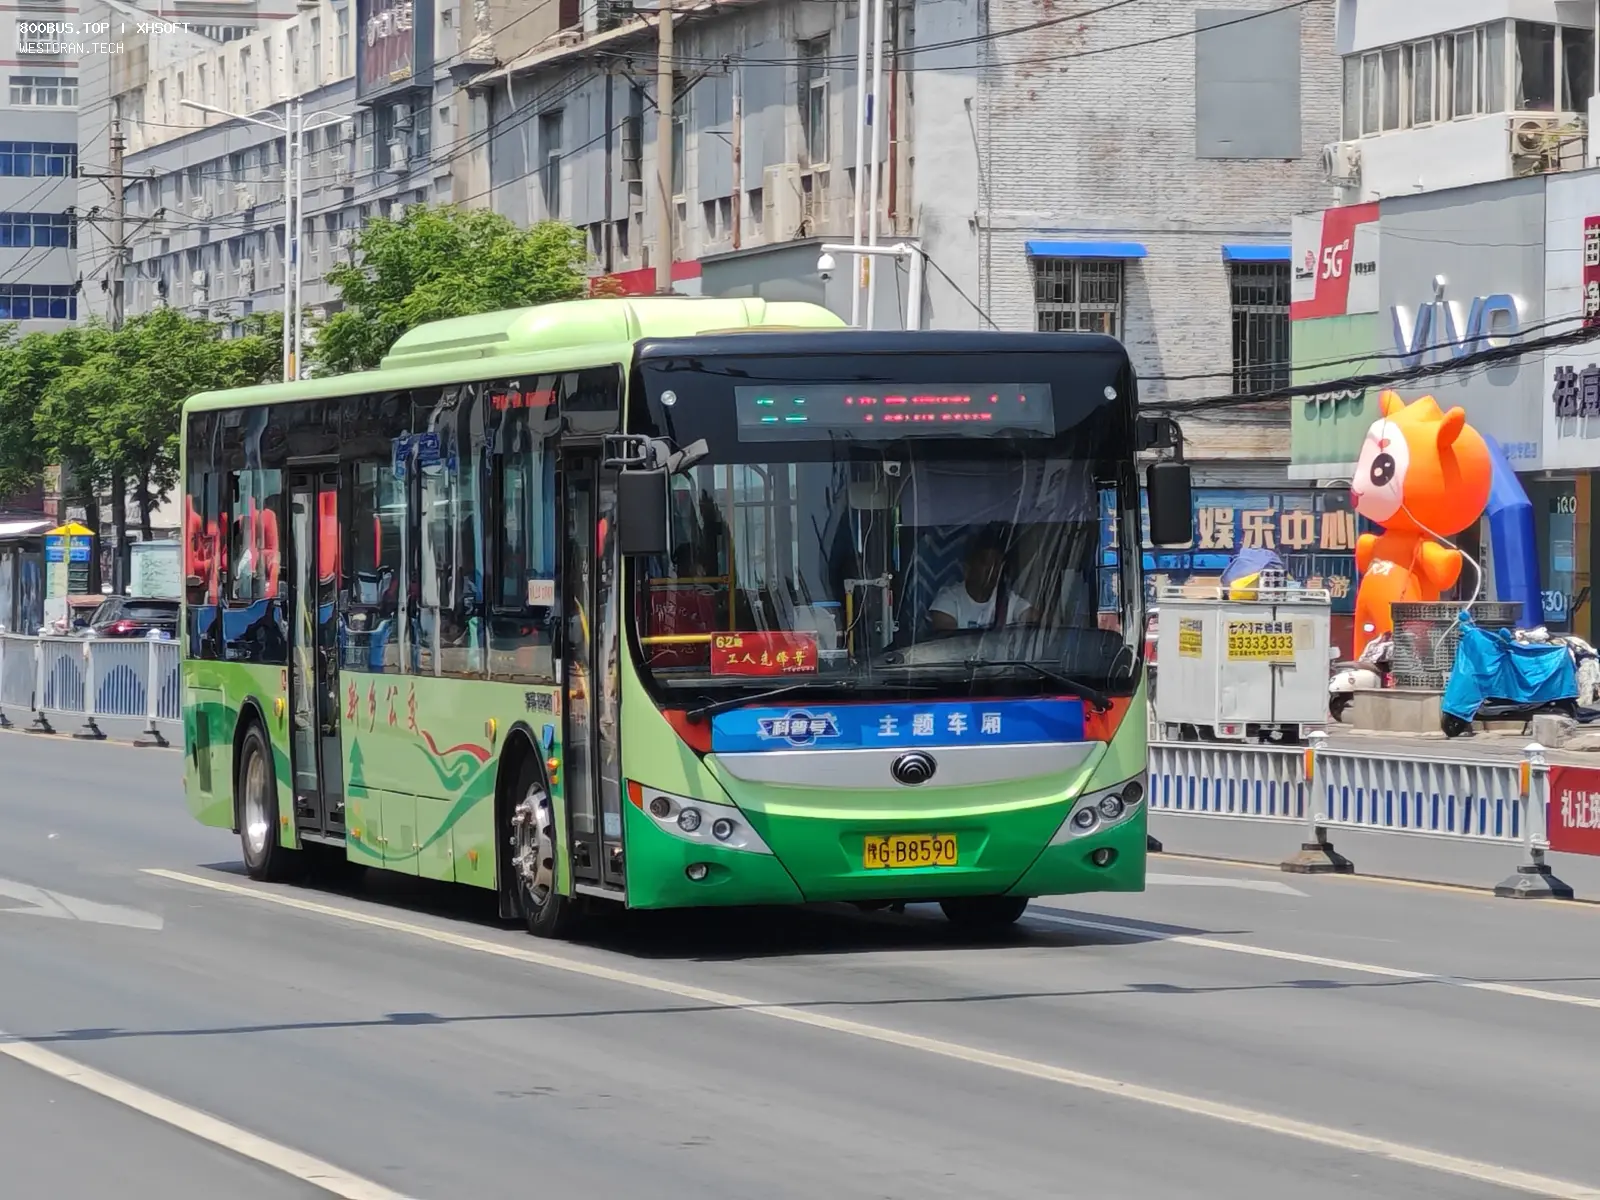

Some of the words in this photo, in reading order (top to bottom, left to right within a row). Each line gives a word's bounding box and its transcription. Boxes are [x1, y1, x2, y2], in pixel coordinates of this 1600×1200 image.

[1390, 274, 1520, 368] vivo
[877, 711, 1002, 737] 主题车厢
